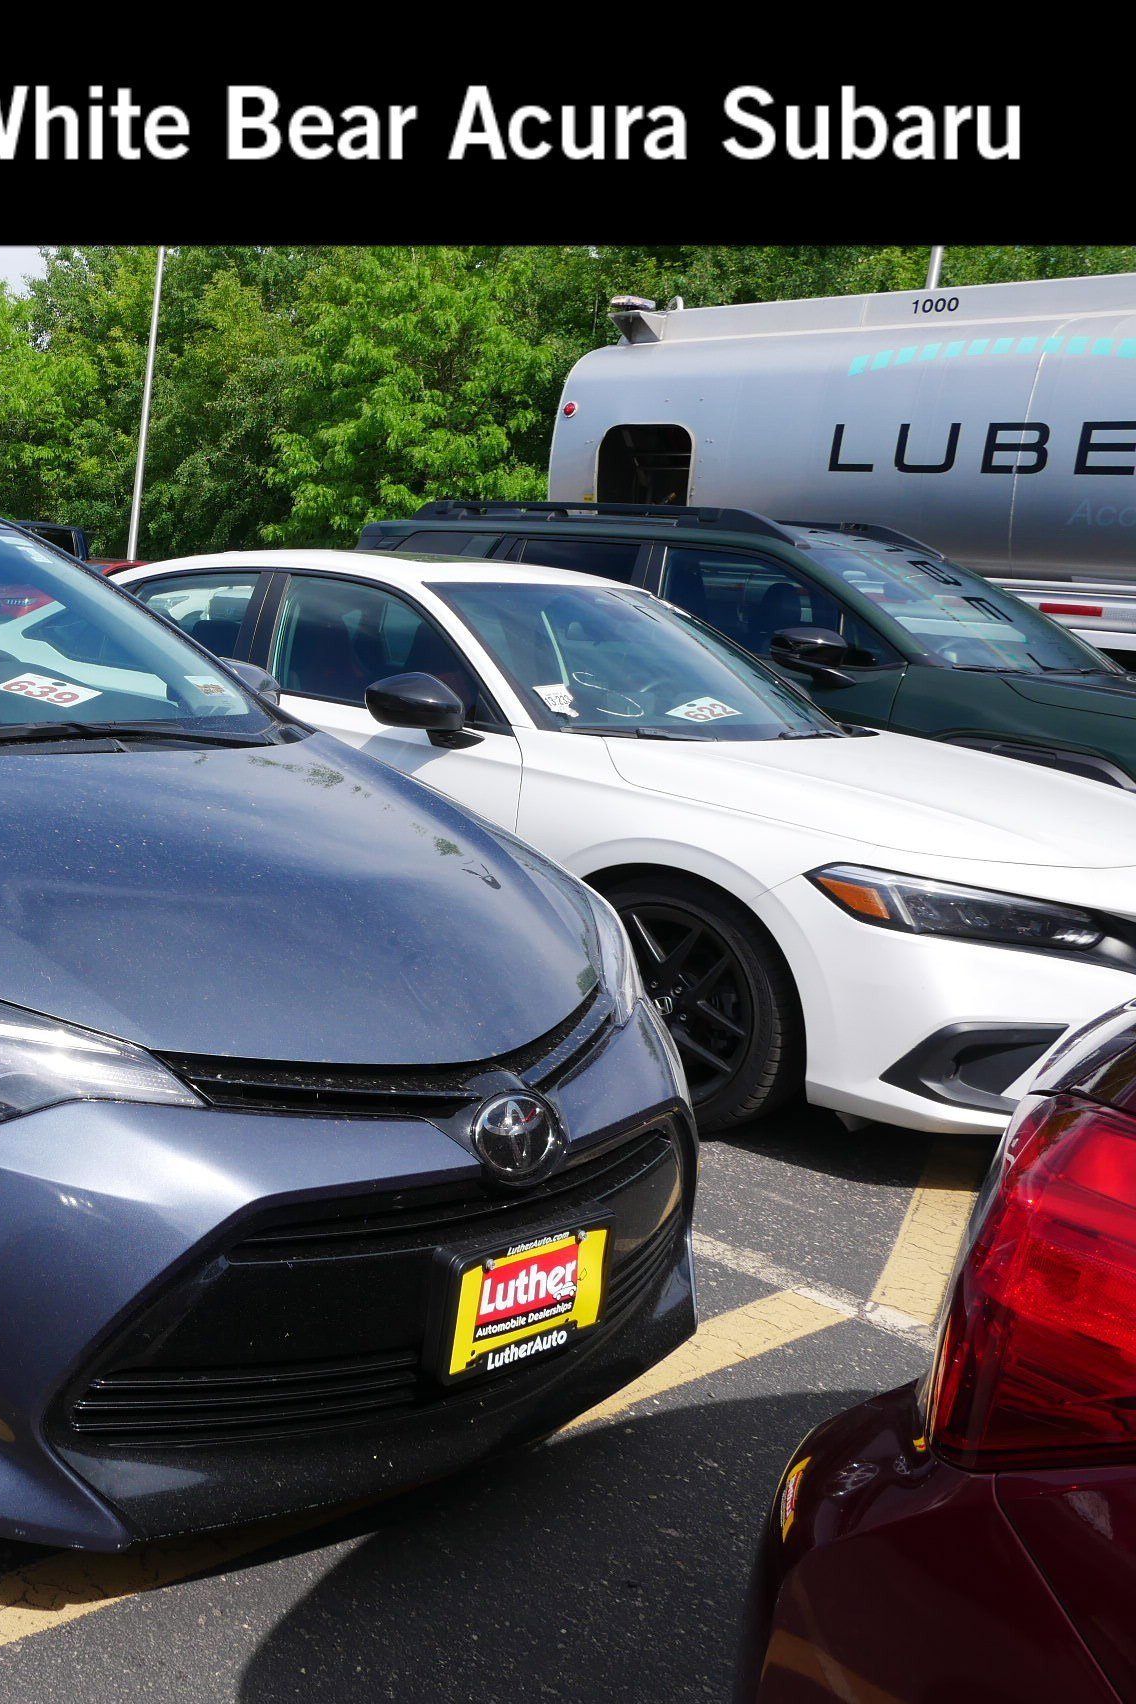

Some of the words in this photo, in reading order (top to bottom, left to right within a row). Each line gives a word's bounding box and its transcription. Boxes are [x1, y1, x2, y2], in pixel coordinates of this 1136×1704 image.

[911, 296, 960, 315] 1000
[2, 680, 80, 704] 639
[684, 703, 731, 722] 622
[506, 1231, 570, 1256] LutherAuto.com
[479, 1260, 577, 1316] Luther
[475, 1316, 527, 1339] Automobile
[527, 1301, 573, 1323] Dealerships
[486, 1330, 568, 1371] LutherAuto
